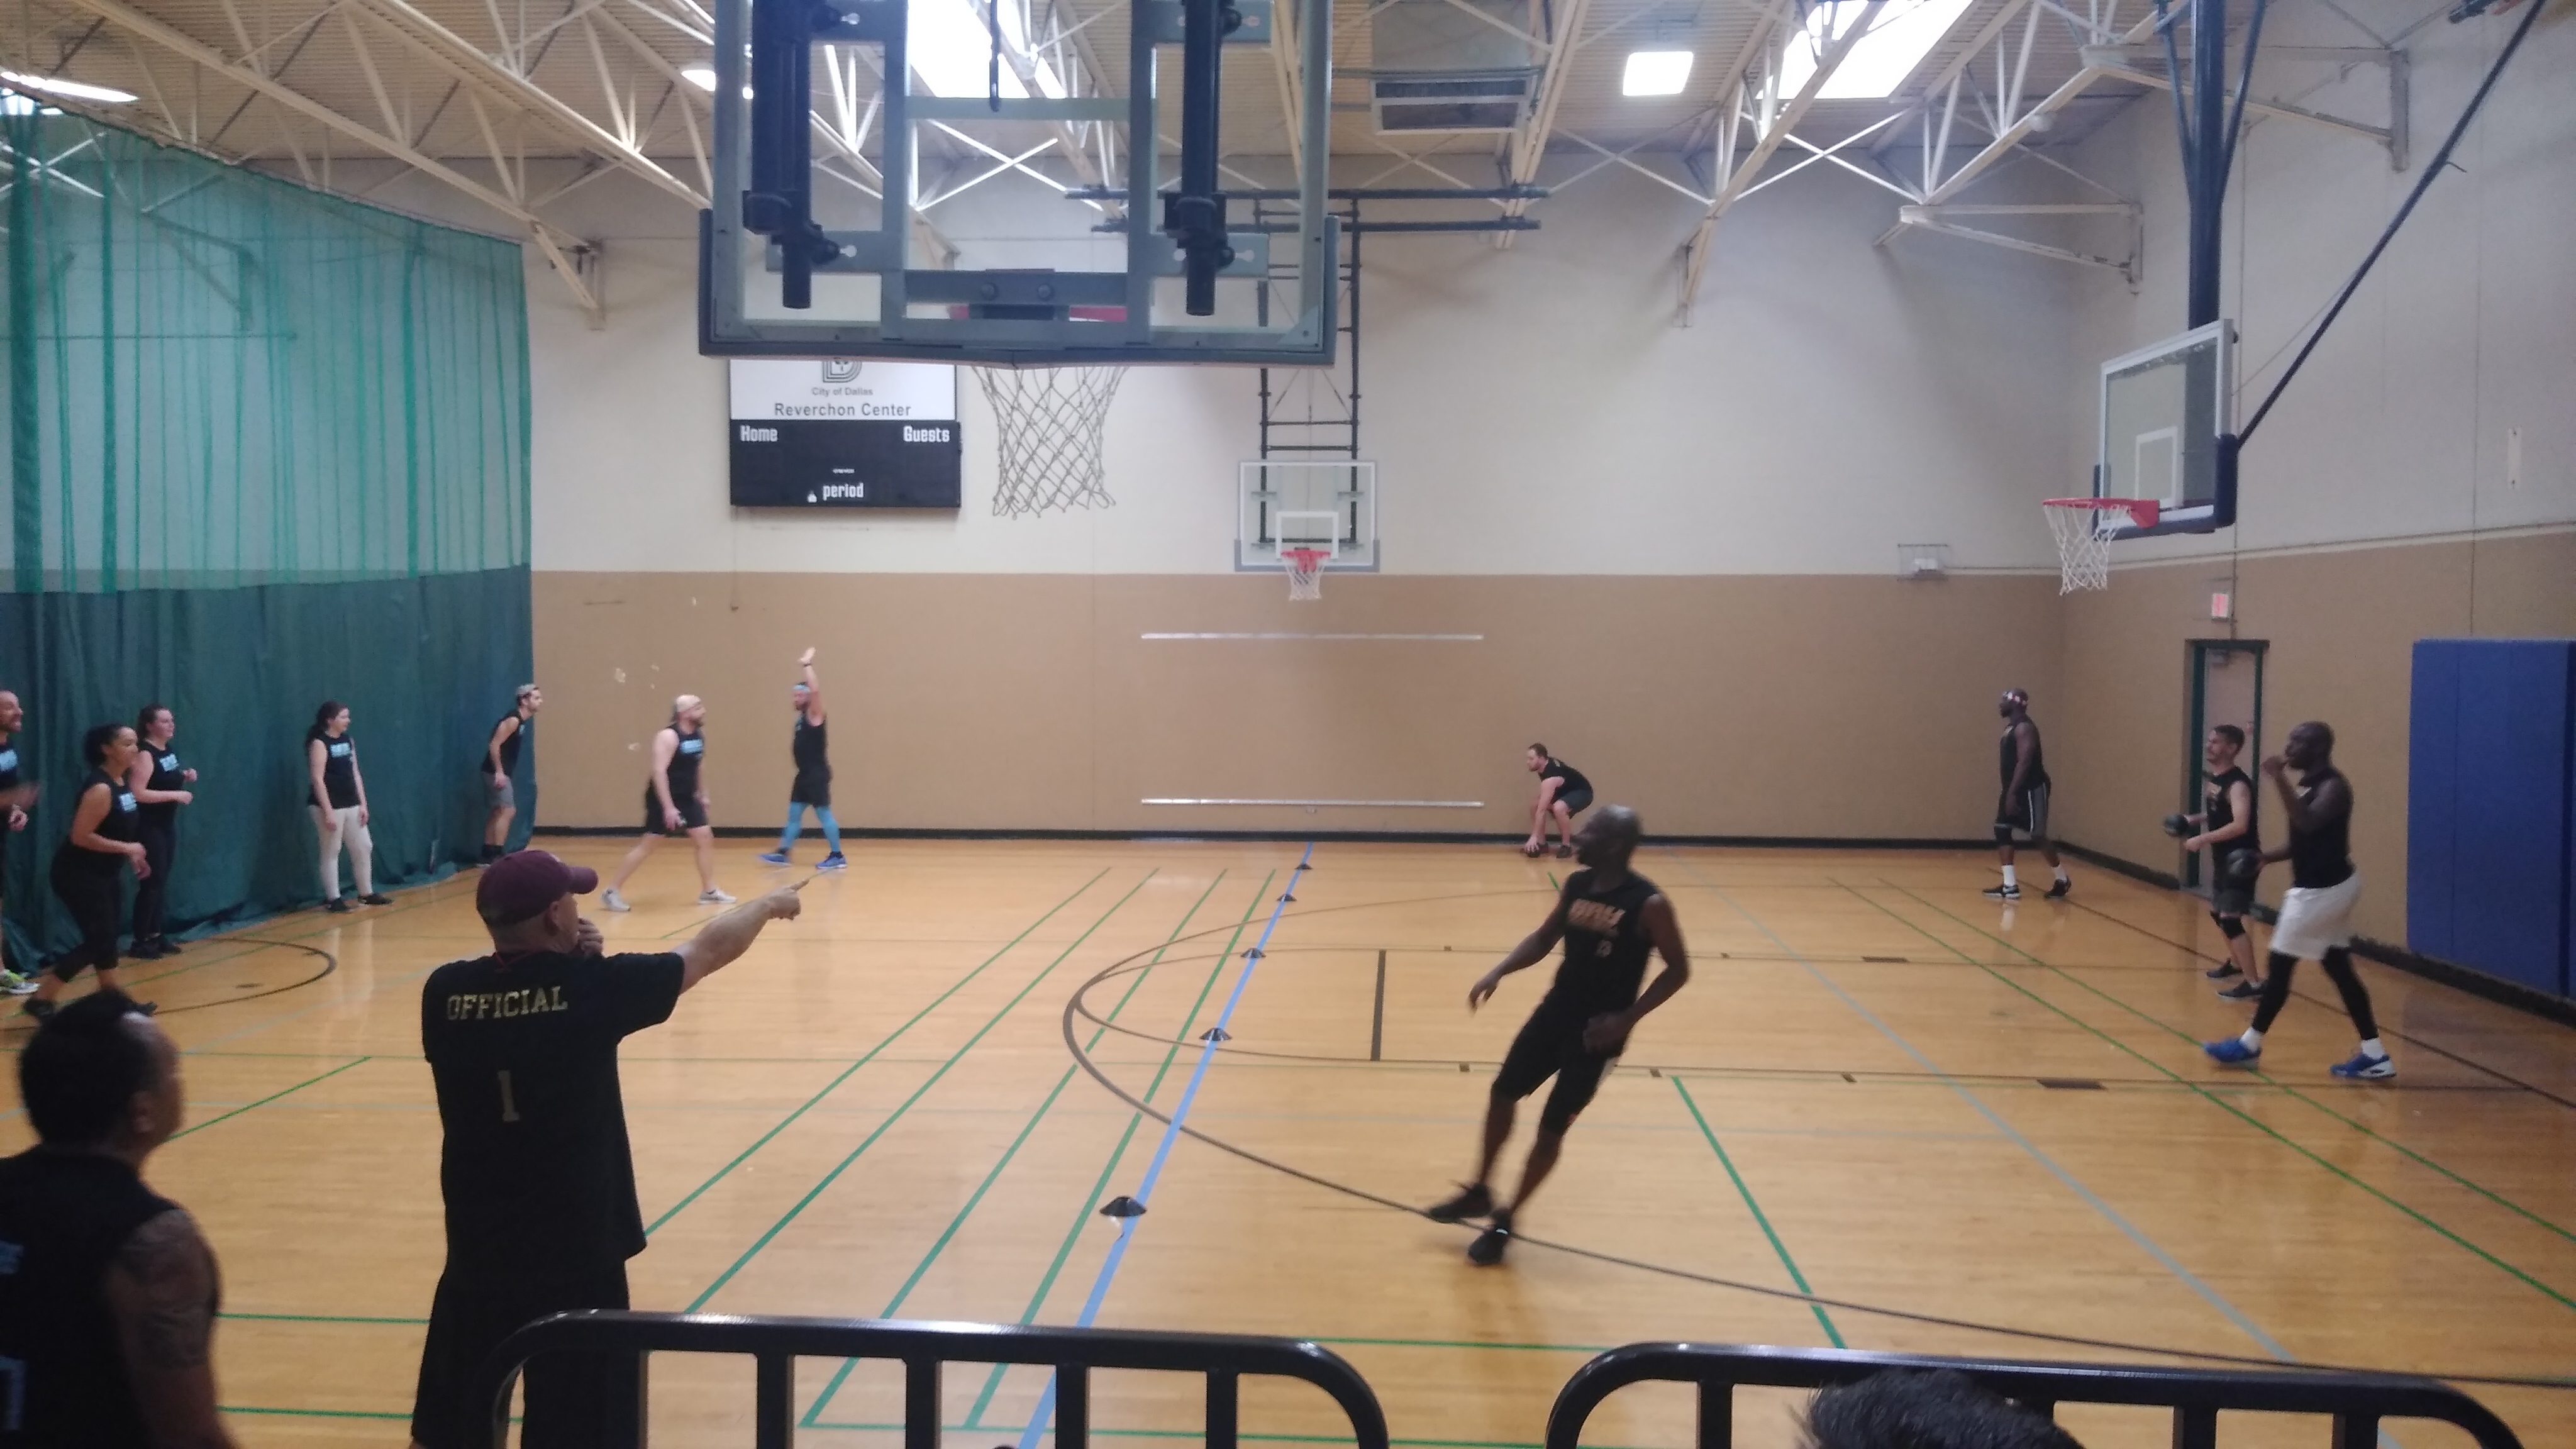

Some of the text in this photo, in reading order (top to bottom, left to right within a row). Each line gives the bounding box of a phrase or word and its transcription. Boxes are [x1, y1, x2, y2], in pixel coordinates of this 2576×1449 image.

[812, 387, 829, 396] City
[845, 387, 874, 396] Dallas
[775, 402, 911, 416] Reverchon Center
[740, 425, 779, 442] Home
[902, 425, 950, 442] Guests
[823, 483, 864, 501] period
[447, 985, 569, 1021] OFFICIAL
[497, 1070, 521, 1121] 1
